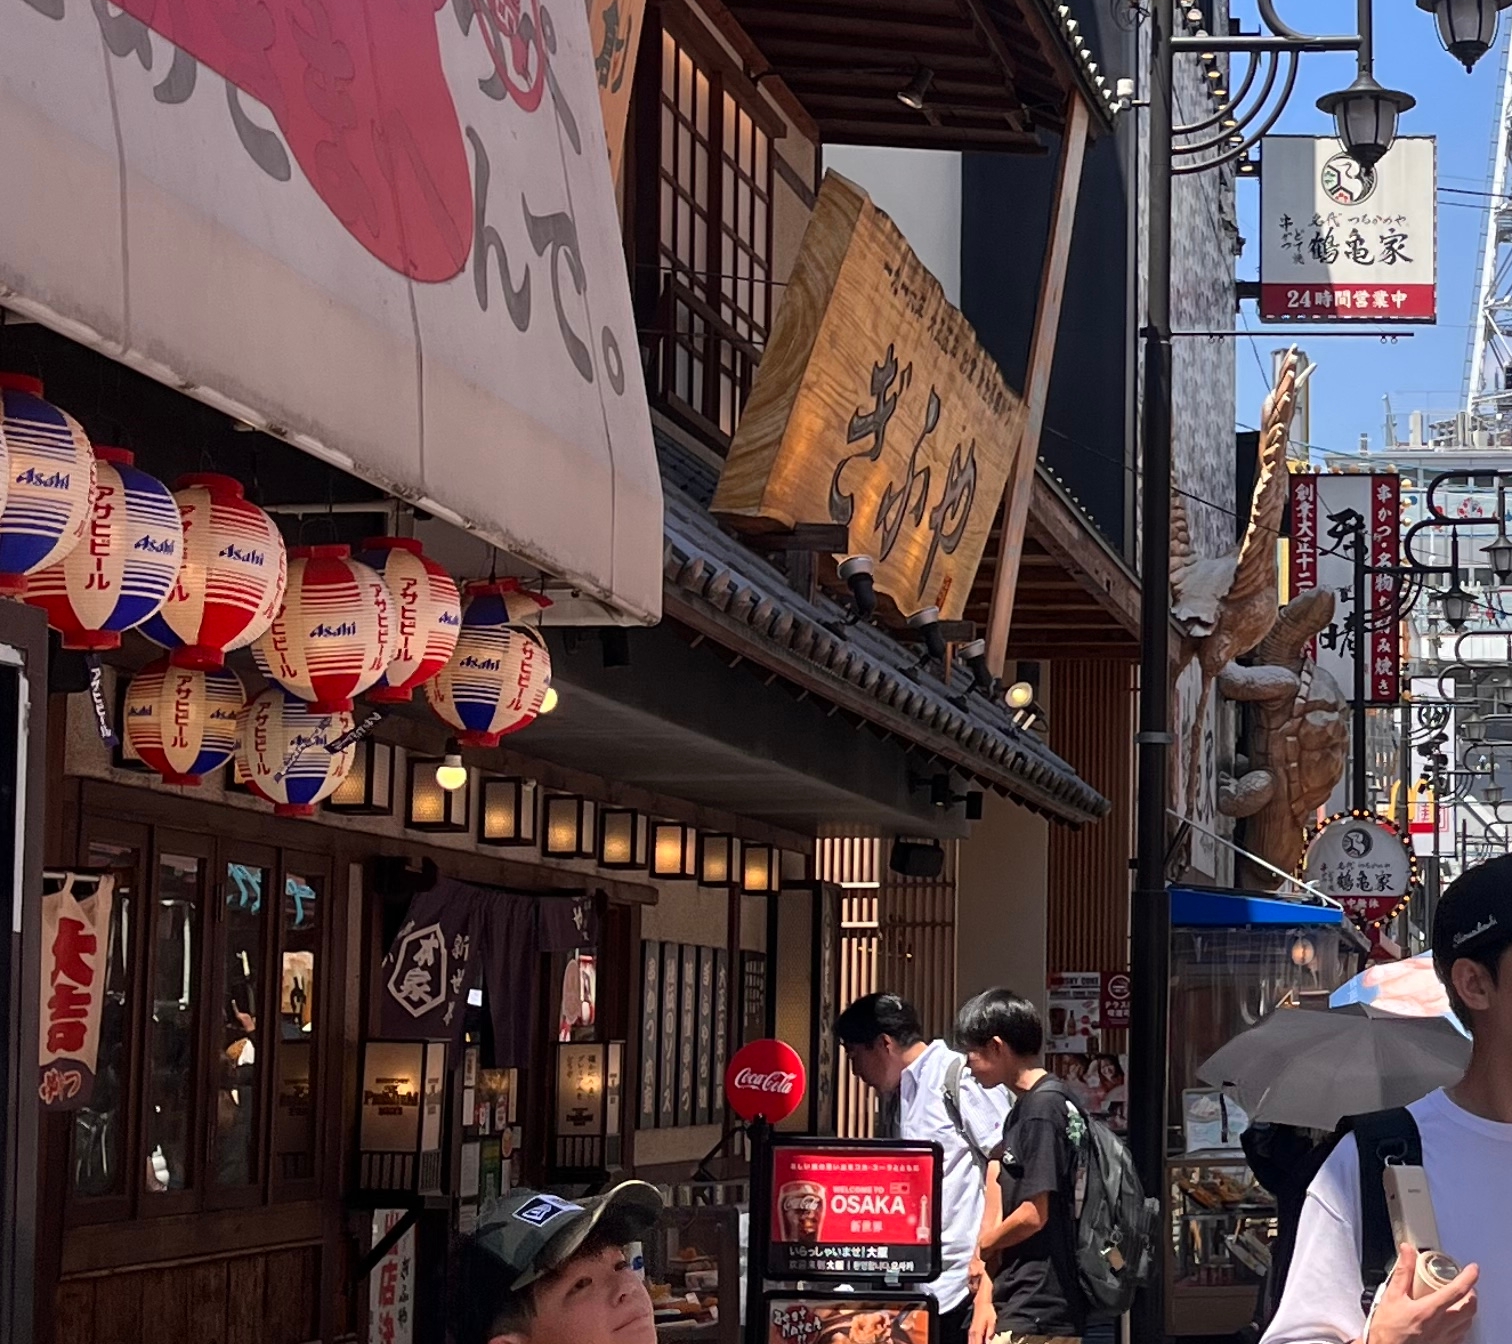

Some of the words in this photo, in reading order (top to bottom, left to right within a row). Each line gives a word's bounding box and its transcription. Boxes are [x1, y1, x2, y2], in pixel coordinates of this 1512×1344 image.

[1308, 227, 1414, 266] 鶴亀家
[1286, 288, 1409, 310] 24時間営業中
[16, 467, 70, 490] Asahi
[85, 485, 115, 591] アサヒビール
[134, 535, 175, 556] Asahi
[219, 543, 265, 567] Asahi
[1295, 482, 1316, 594] 創業大正十二
[309, 619, 358, 639] Asahi
[367, 582, 392, 672] アサヒビール
[395, 576, 420, 663] アサヒビール
[459, 654, 501, 672] Asahi
[170, 673, 193, 750] アサヒビール
[252, 700, 273, 777] アサヒビール
[48, 917, 97, 1056] 大吉
[734, 1066, 798, 1095] Coca-Cola
[830, 1194, 907, 1215] OSAKA
